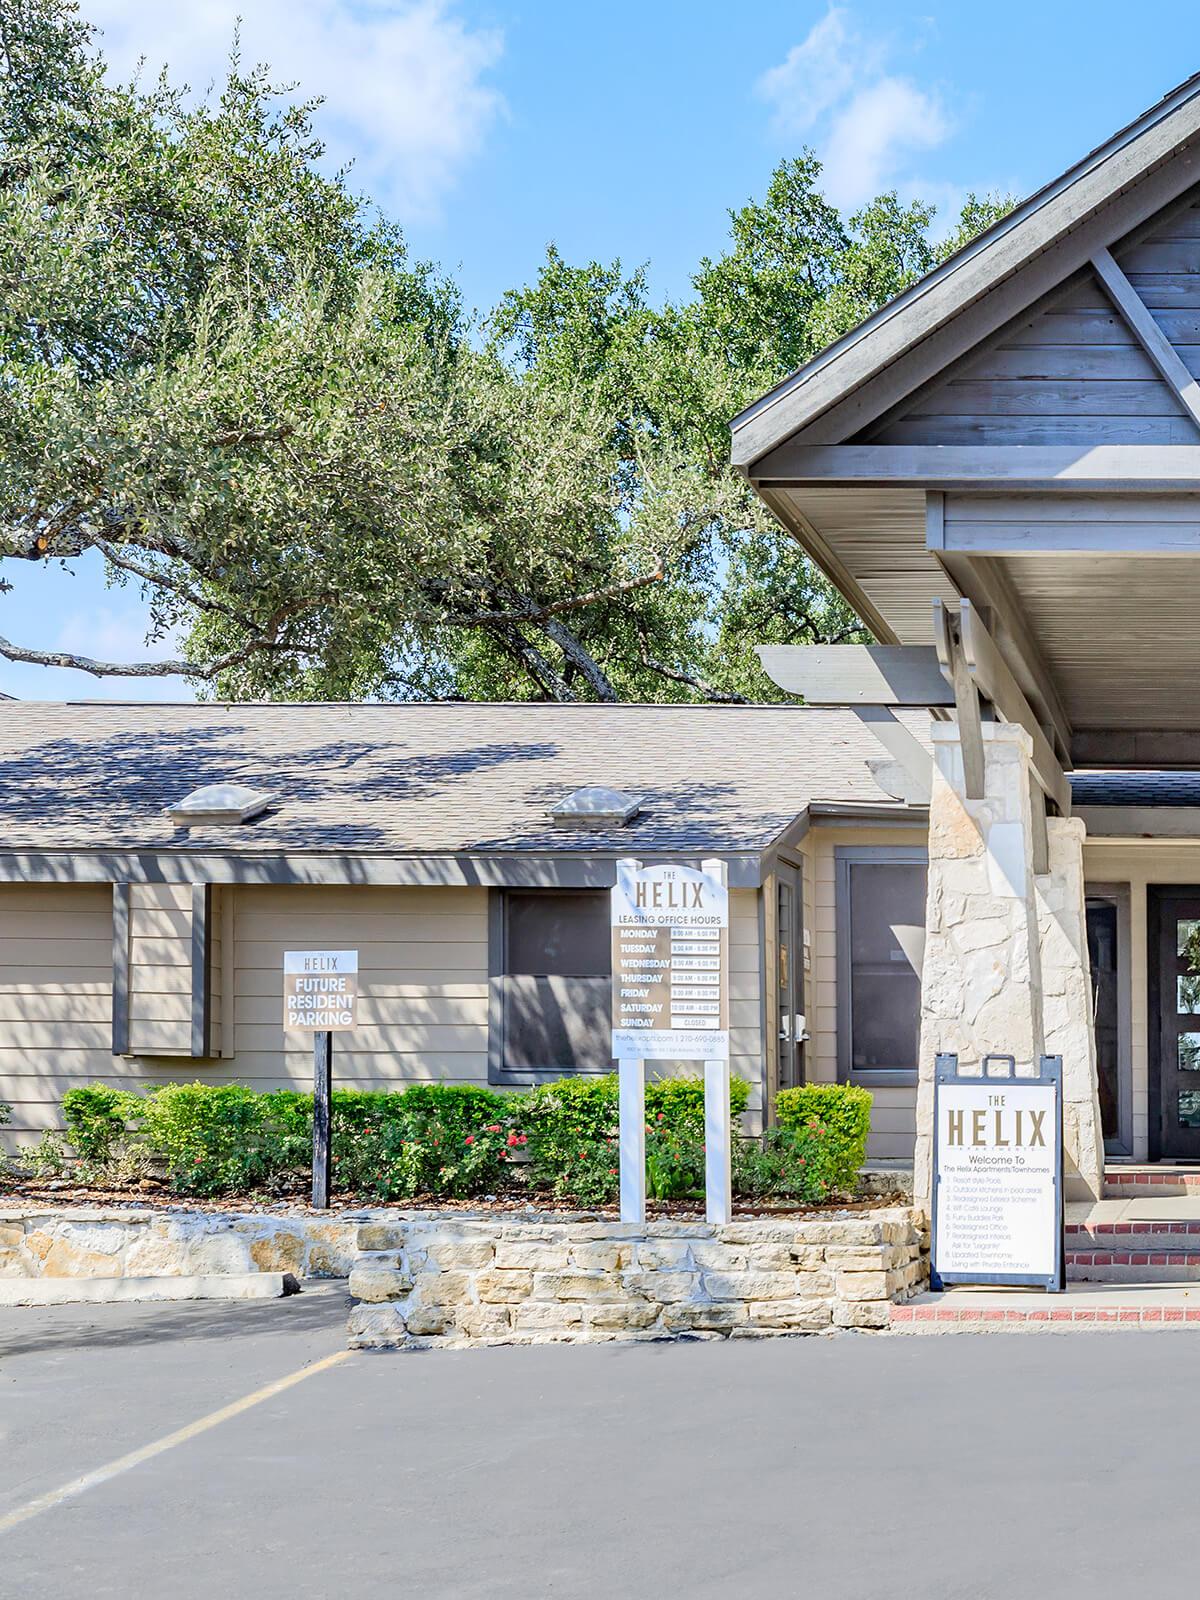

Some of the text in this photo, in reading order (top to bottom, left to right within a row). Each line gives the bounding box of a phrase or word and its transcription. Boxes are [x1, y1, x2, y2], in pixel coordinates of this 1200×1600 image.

[663, 871, 676, 880] THE
[636, 881, 704, 908] HELIX
[619, 915, 721, 925] LEASING OFFICE HOURS
[620, 930, 658, 939] MONDAY
[620, 944, 656, 953] TUESDAY
[304, 957, 338, 970] HELIX
[620, 959, 671, 968] WEDNESDAY
[620, 974, 663, 983] THURSDAY
[295, 977, 346, 993] FUTURE
[620, 988, 650, 998] FRIDAY
[287, 994, 354, 1009] RESIDENT
[620, 1003, 663, 1012] SATURDAY
[288, 1011, 353, 1026] PARKING
[620, 1018, 654, 1027] SUNDAY
[988, 1095, 1006, 1106] THE
[947, 1110, 1047, 1147] HELIX
[969, 1155, 1025, 1165] Welcome To
[956, 1165, 972, 1173] Helix
